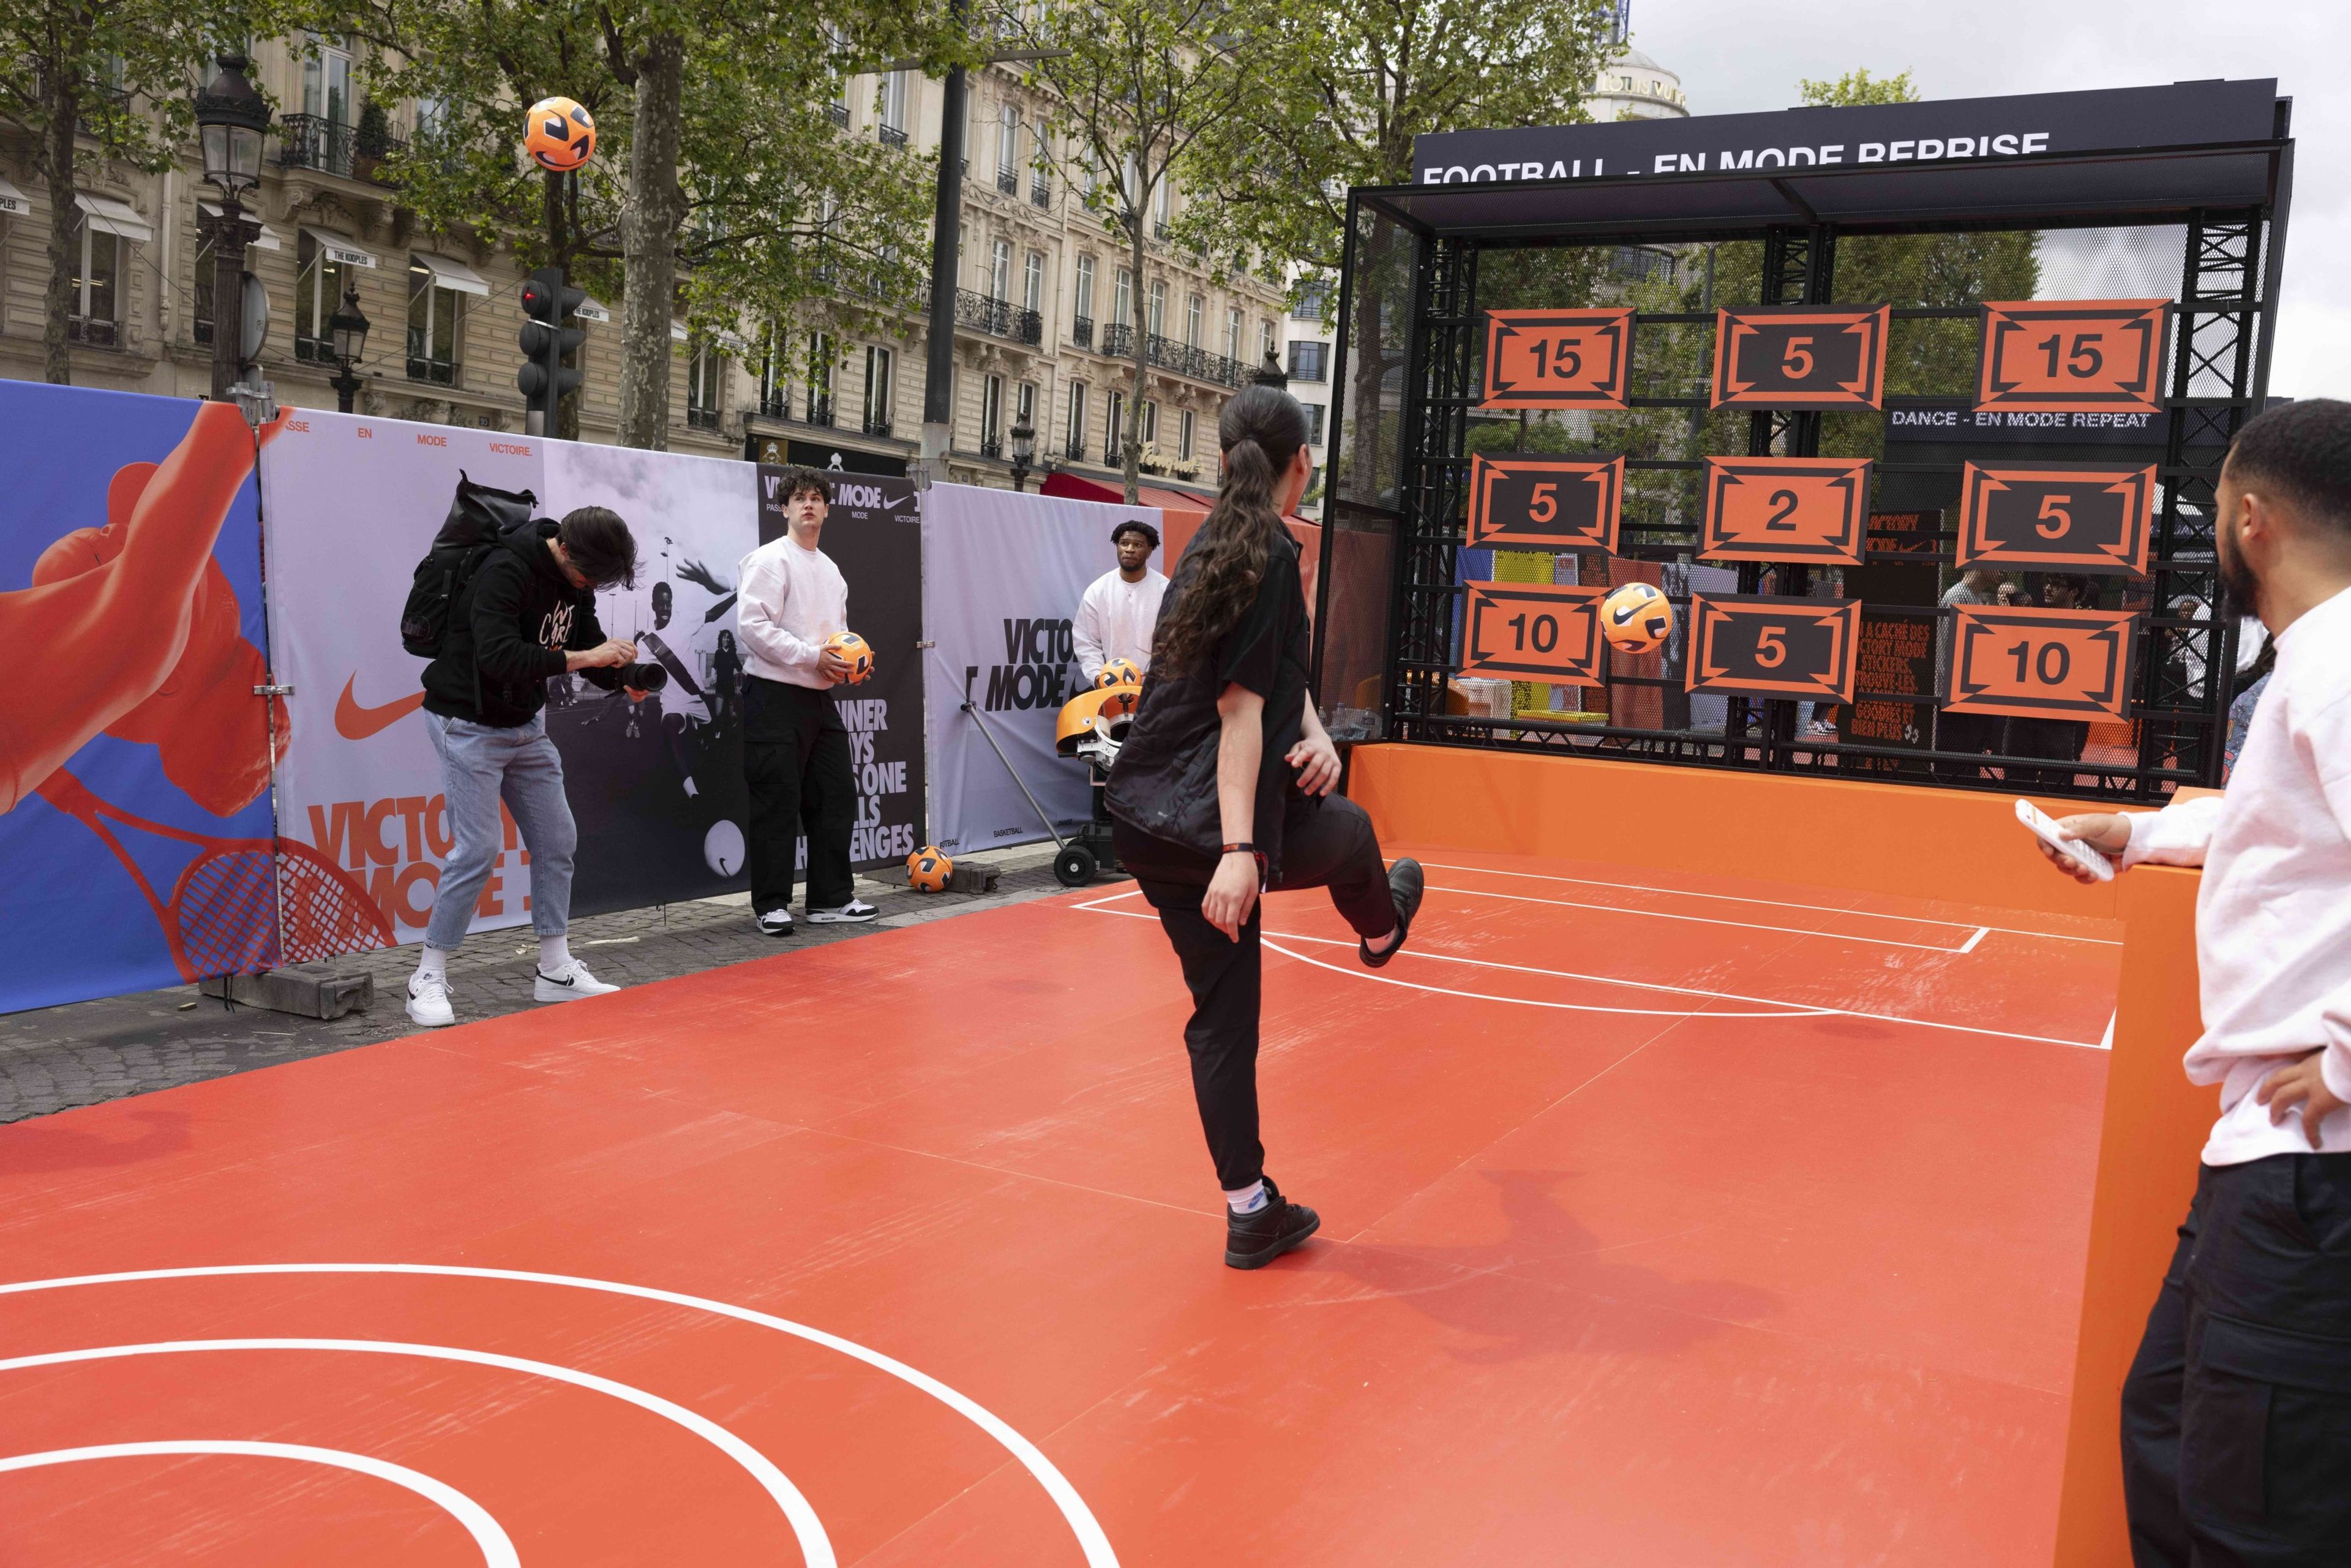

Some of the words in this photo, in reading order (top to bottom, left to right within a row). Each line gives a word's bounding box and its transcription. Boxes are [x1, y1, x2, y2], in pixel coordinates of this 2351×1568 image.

[1601, 76, 1650, 95] LOUIS
[1654, 152, 1706, 173] EN
[1719, 144, 1845, 170] MODE
[1858, 132, 2050, 163] REPRISE
[334, 250, 345, 261] THE
[345, 252, 367, 265] KOOPLES
[1529, 339, 1581, 379] 15
[1782, 337, 1813, 379] 5
[2038, 333, 2104, 378] 15
[1891, 411, 1958, 426] DANCE
[1974, 413, 2002, 427] EN
[2006, 413, 2066, 427] MODE
[2072, 413, 2153, 429] REPEAT
[358, 428, 372, 439] EN
[417, 434, 447, 448] MODE
[489, 442, 533, 457] VICTOIRE.
[766, 503, 782, 512] PASS
[851, 511, 868, 520] MODE
[838, 484, 881, 509] MODE
[1529, 483, 1557, 523] 5
[1766, 489, 1798, 531] 2
[2036, 495, 2071, 539] 5
[1003, 618, 1078, 664] VICTO
[1508, 613, 1559, 653] 10
[1755, 626, 1787, 668] 5
[2008, 640, 2071, 685] 10
[984, 664, 1068, 712] MODE
[862, 761, 907, 796] ONE
[994, 827, 1023, 838] BASKETBALL
